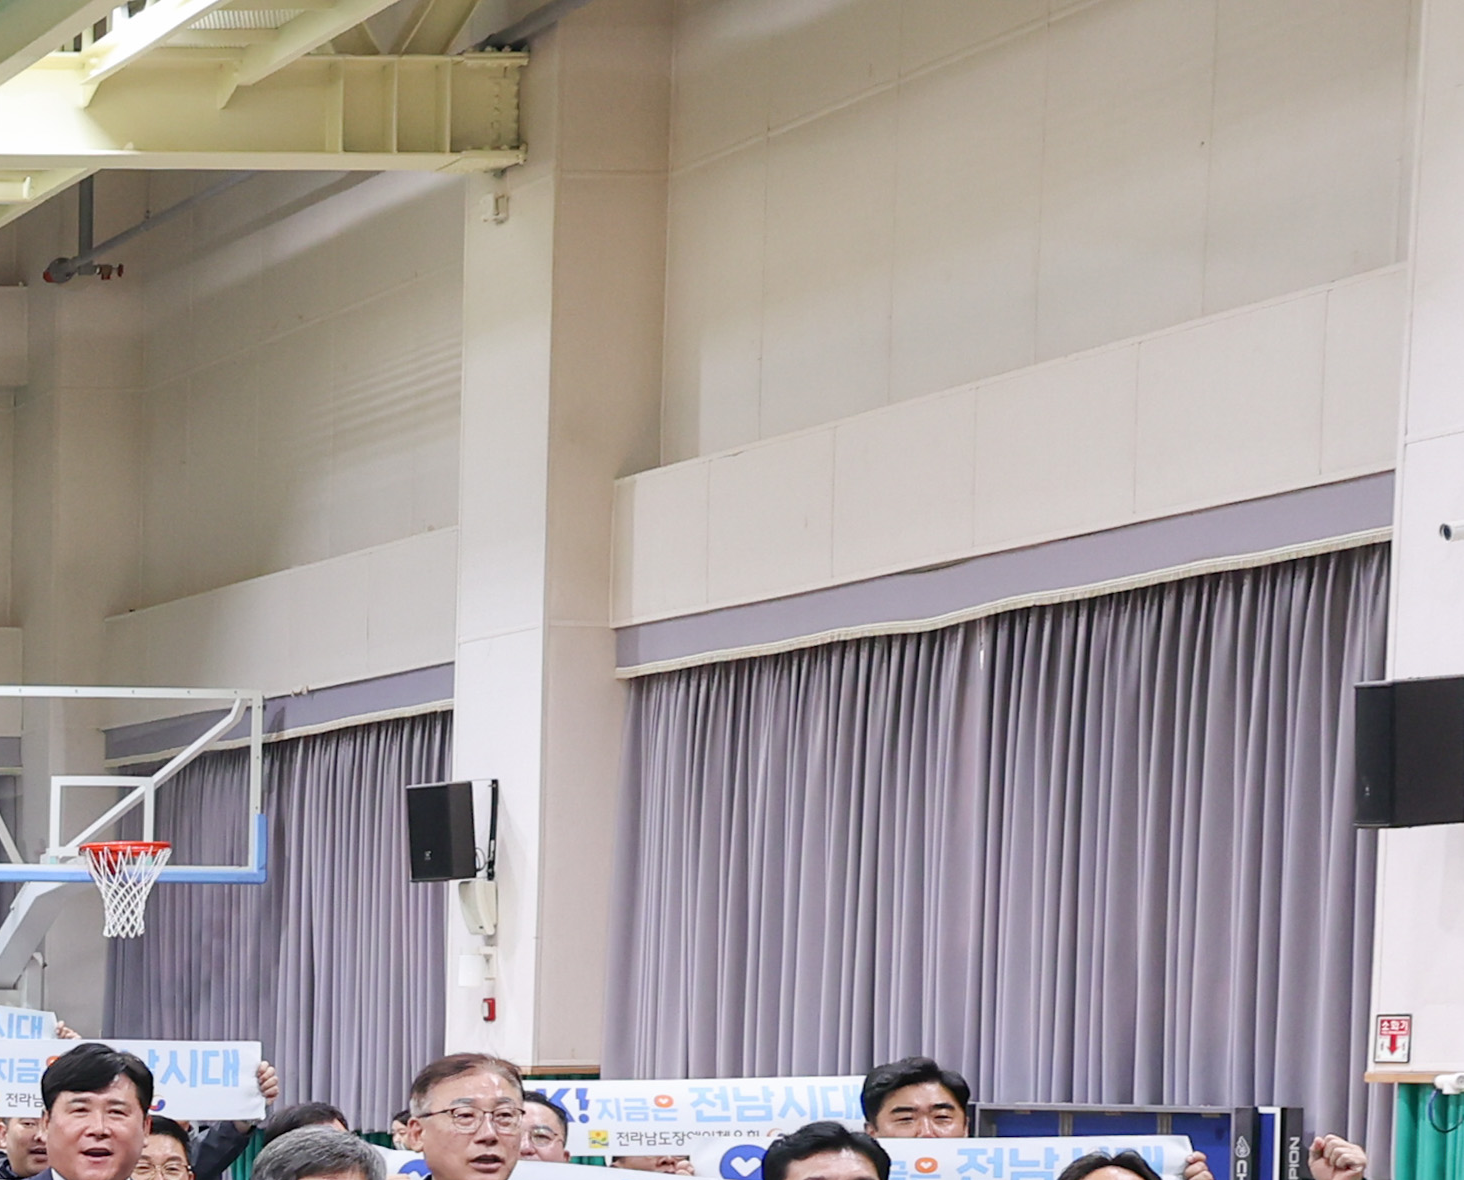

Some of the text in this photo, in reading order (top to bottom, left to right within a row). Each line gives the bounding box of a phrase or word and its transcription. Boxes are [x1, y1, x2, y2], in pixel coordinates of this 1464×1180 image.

[1381, 1019, 1408, 1031] 소화기
[595, 1093, 679, 1123] 지금은
[690, 1084, 863, 1123] 전남시대
